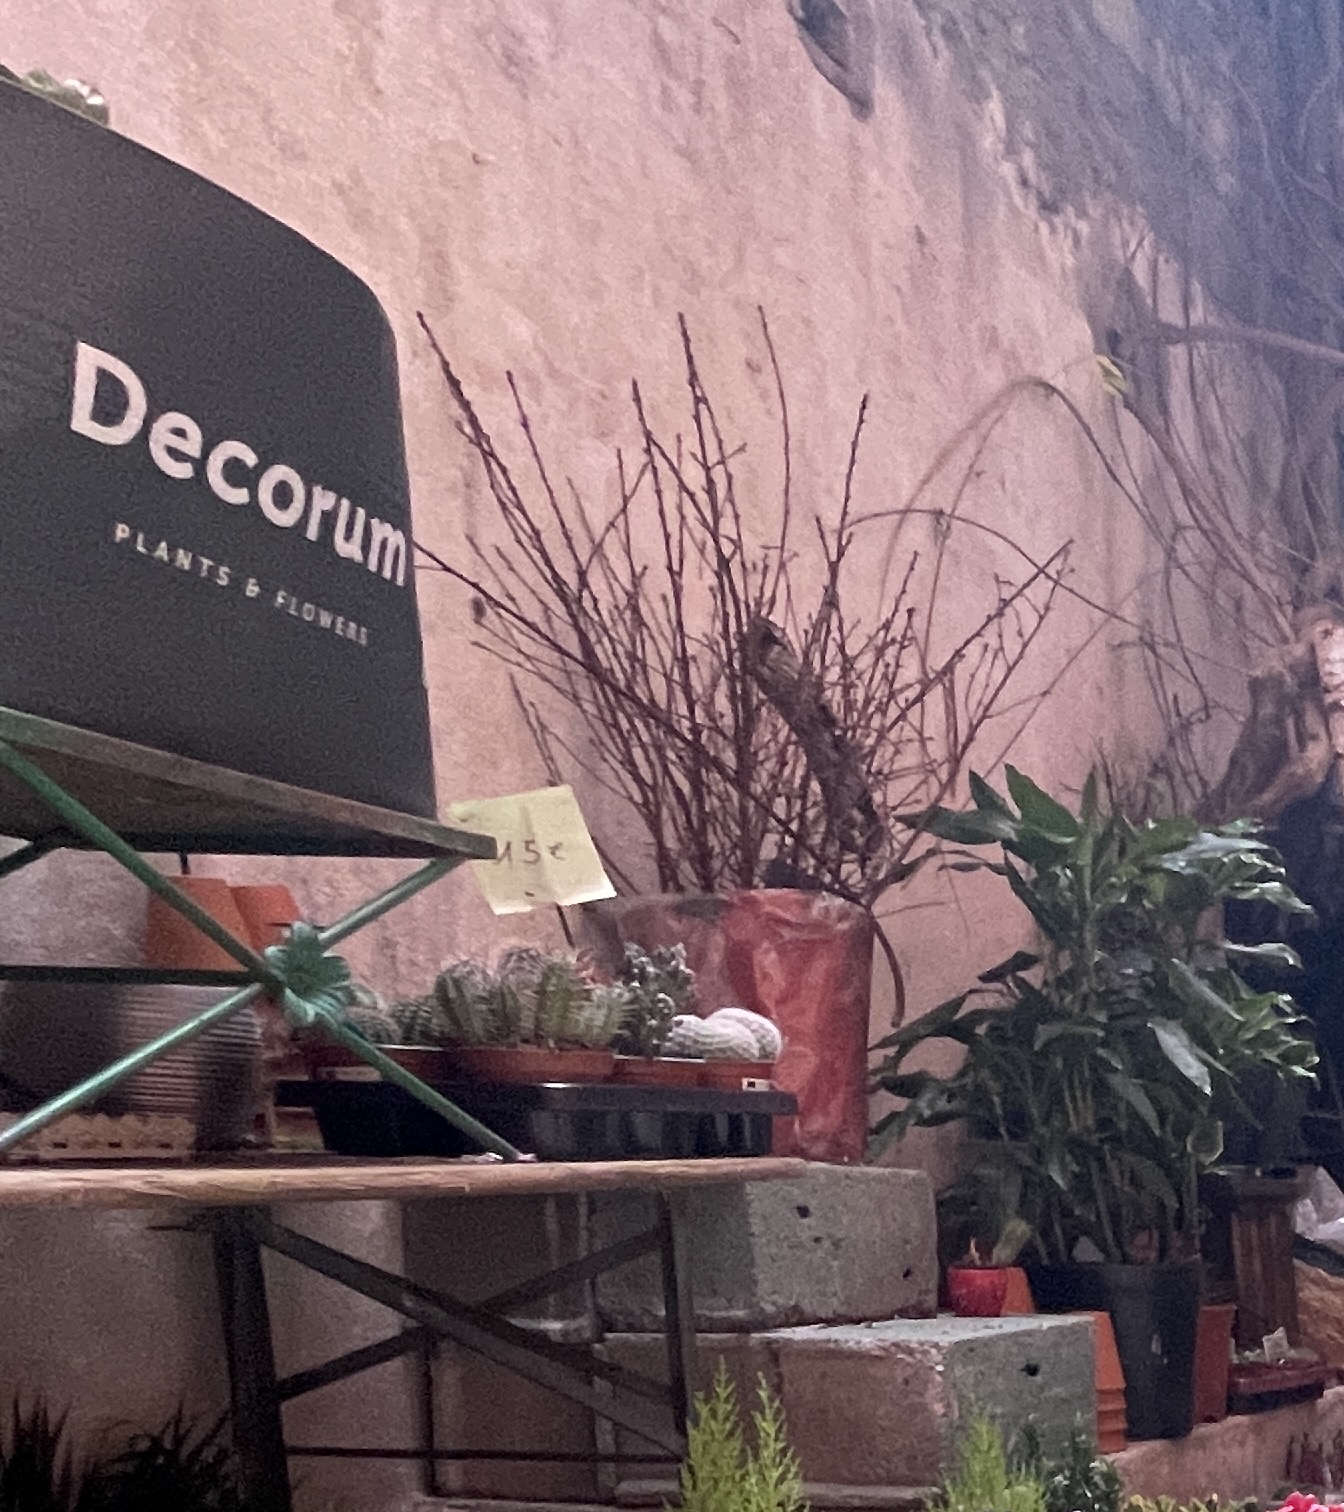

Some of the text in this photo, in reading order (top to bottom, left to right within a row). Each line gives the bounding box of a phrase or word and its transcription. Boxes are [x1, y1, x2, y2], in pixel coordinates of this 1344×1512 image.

[70, 341, 409, 587] Decorum
[114, 522, 369, 647] PLANTS & FLOWERS
